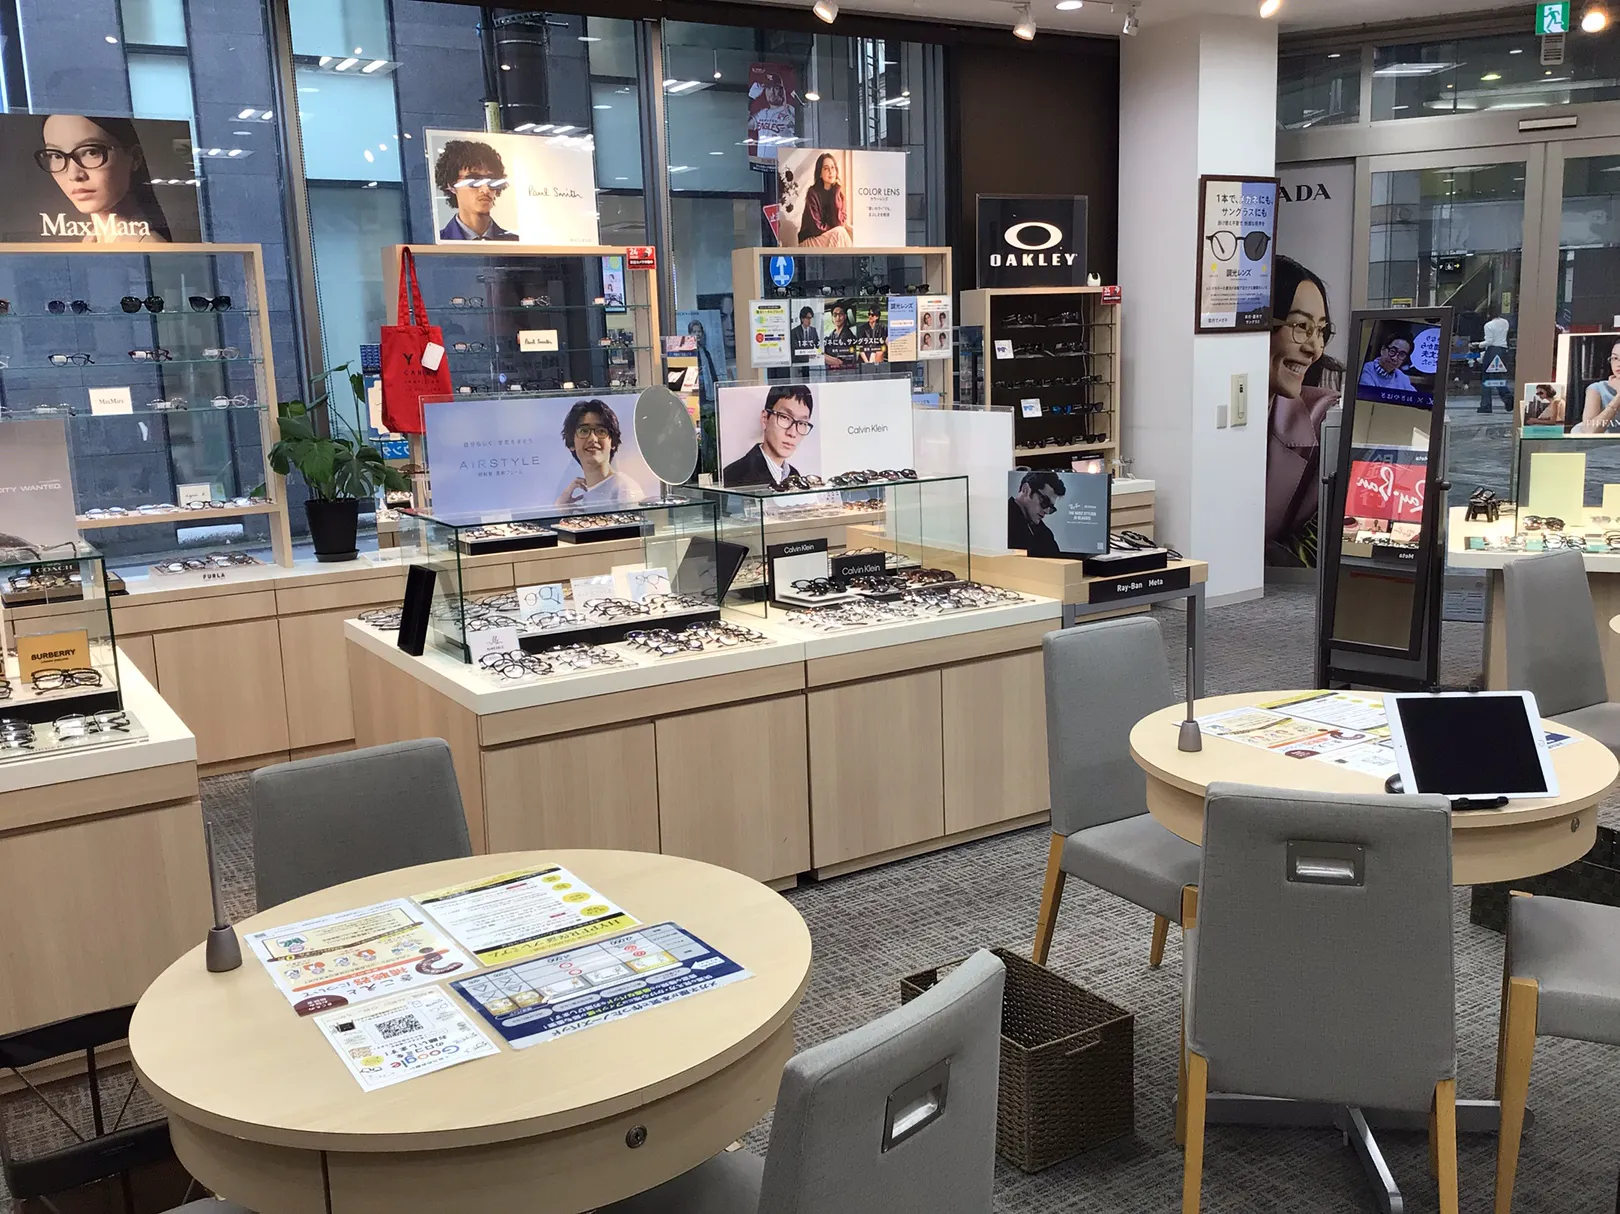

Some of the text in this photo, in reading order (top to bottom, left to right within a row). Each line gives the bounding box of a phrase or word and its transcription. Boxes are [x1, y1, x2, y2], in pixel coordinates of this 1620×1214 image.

[528, 186, 583, 198] Paul Smith
[858, 187, 900, 196] COLOR LENS
[1222, 208, 1267, 217] サングラスにも
[39, 212, 151, 237] MaxMara
[989, 253, 1076, 267] OAKLEY
[890, 302, 914, 310] 調光レンズ
[847, 424, 888, 434] Calvin Klein
[459, 456, 540, 470] AIRSTYLE
[783, 543, 815, 554] Calvin Klein
[35, 564, 73, 573] COACH
[841, 564, 881, 576] Calvin Klein
[1116, 578, 1164, 592] Ray-Ban Meta
[31, 649, 76, 661] BURBERRY
[387, 1042, 462, 1070] Google
